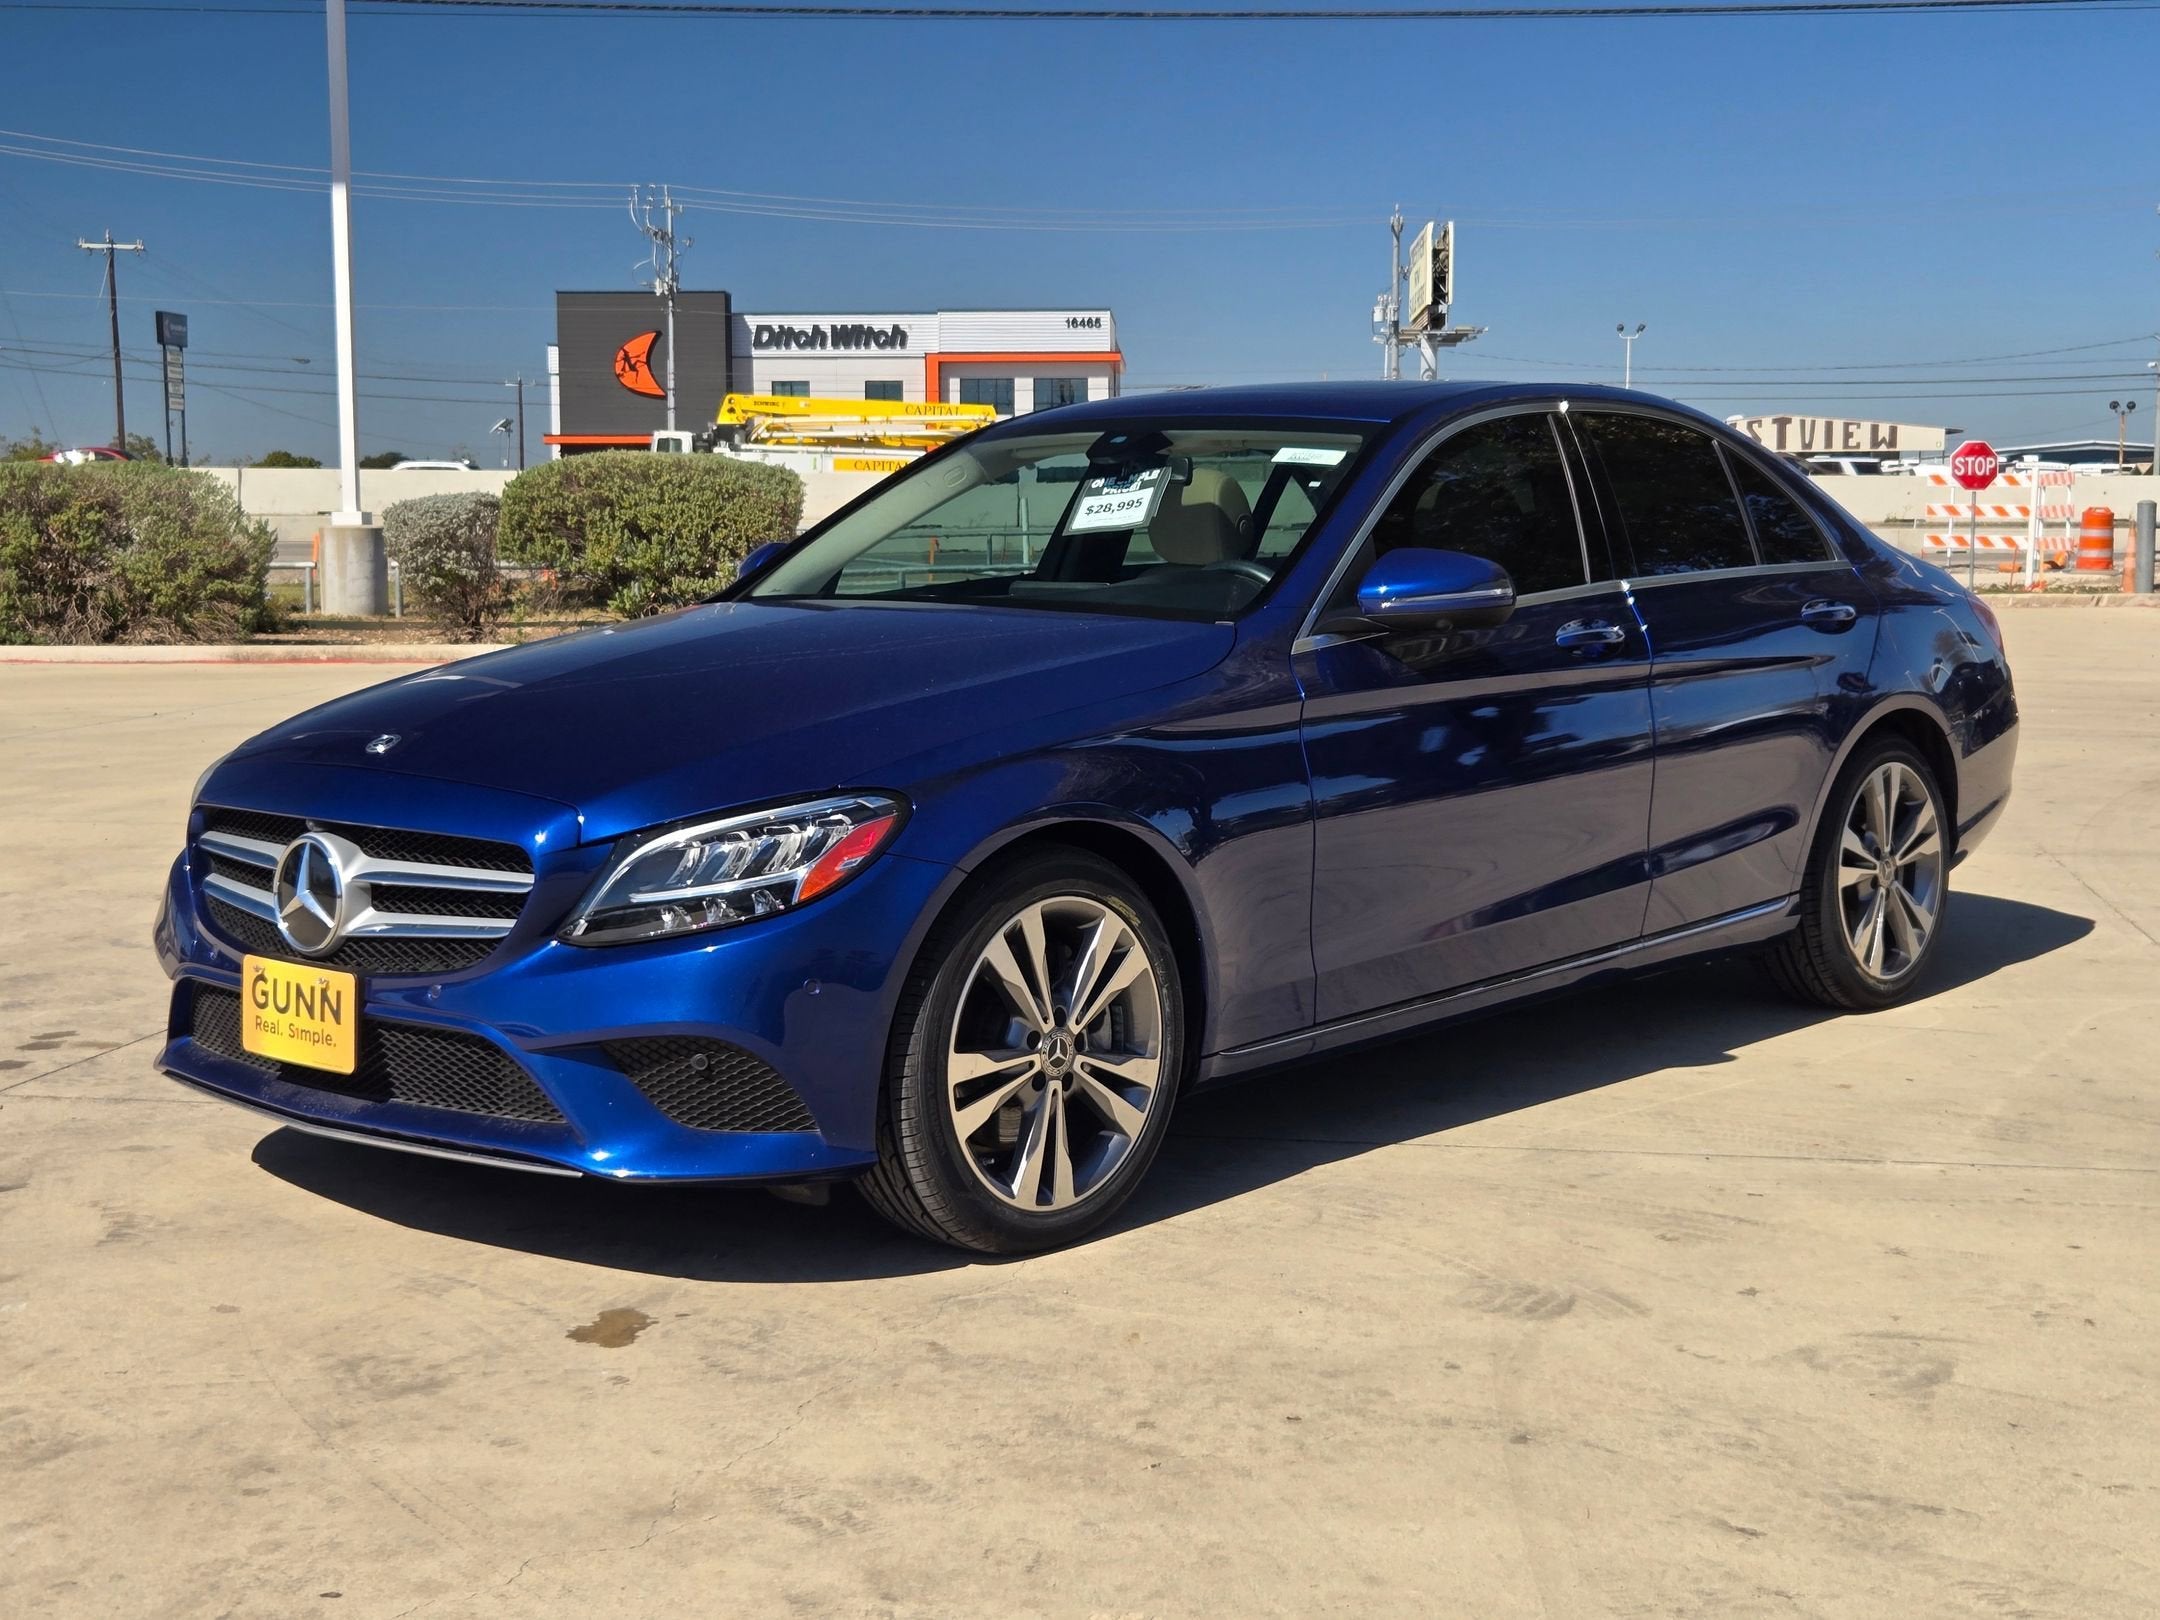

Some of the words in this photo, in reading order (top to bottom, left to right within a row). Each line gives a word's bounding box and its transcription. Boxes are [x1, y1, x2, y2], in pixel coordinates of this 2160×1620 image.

[753, 324, 827, 350] Ditch
[830, 324, 909, 350] Witch
[905, 404, 962, 416] CAPITAL
[854, 460, 906, 472] CAPITA
[1954, 457, 1996, 476] STOP
[1085, 498, 1144, 516] $28,995
[252, 973, 342, 1025] GUNN
[255, 1015, 283, 1036] Real.
